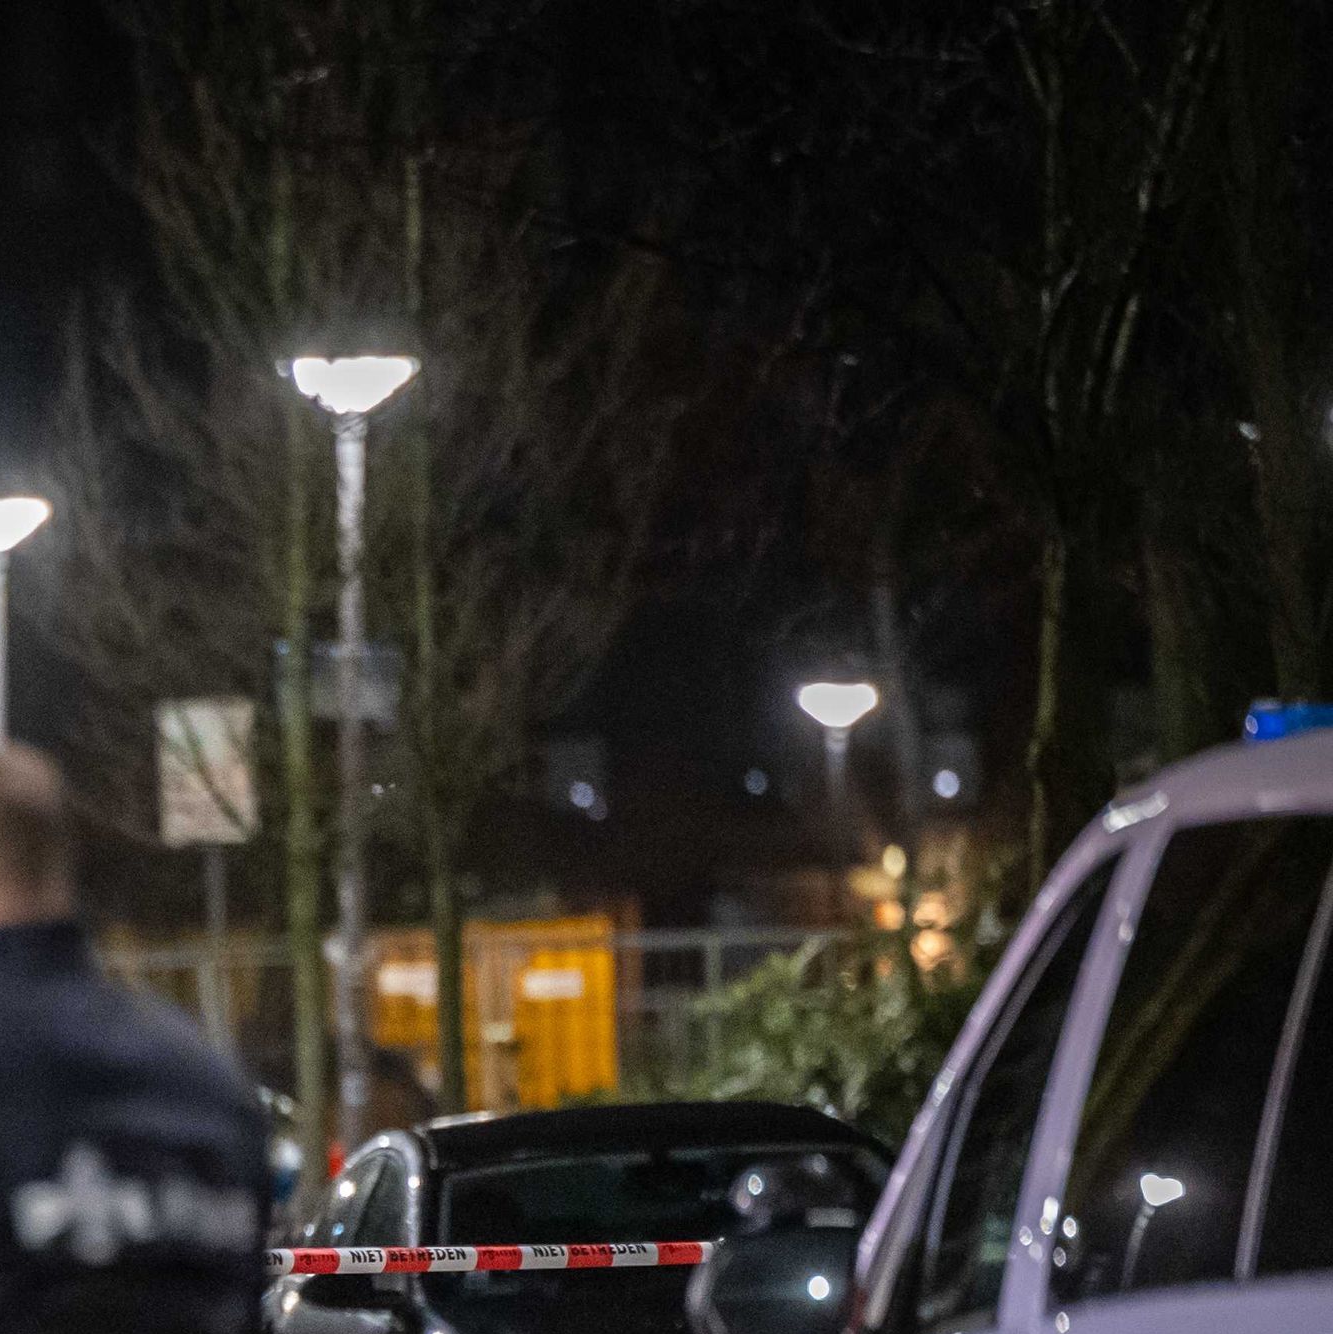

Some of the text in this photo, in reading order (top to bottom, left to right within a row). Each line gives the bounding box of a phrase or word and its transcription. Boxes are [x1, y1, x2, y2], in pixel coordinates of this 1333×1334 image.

[350, 1249, 383, 1263] NIET
[389, 1248, 467, 1262] BETREDEN
[533, 1246, 565, 1258] NIET
[571, 1244, 647, 1256] BETREDEN
